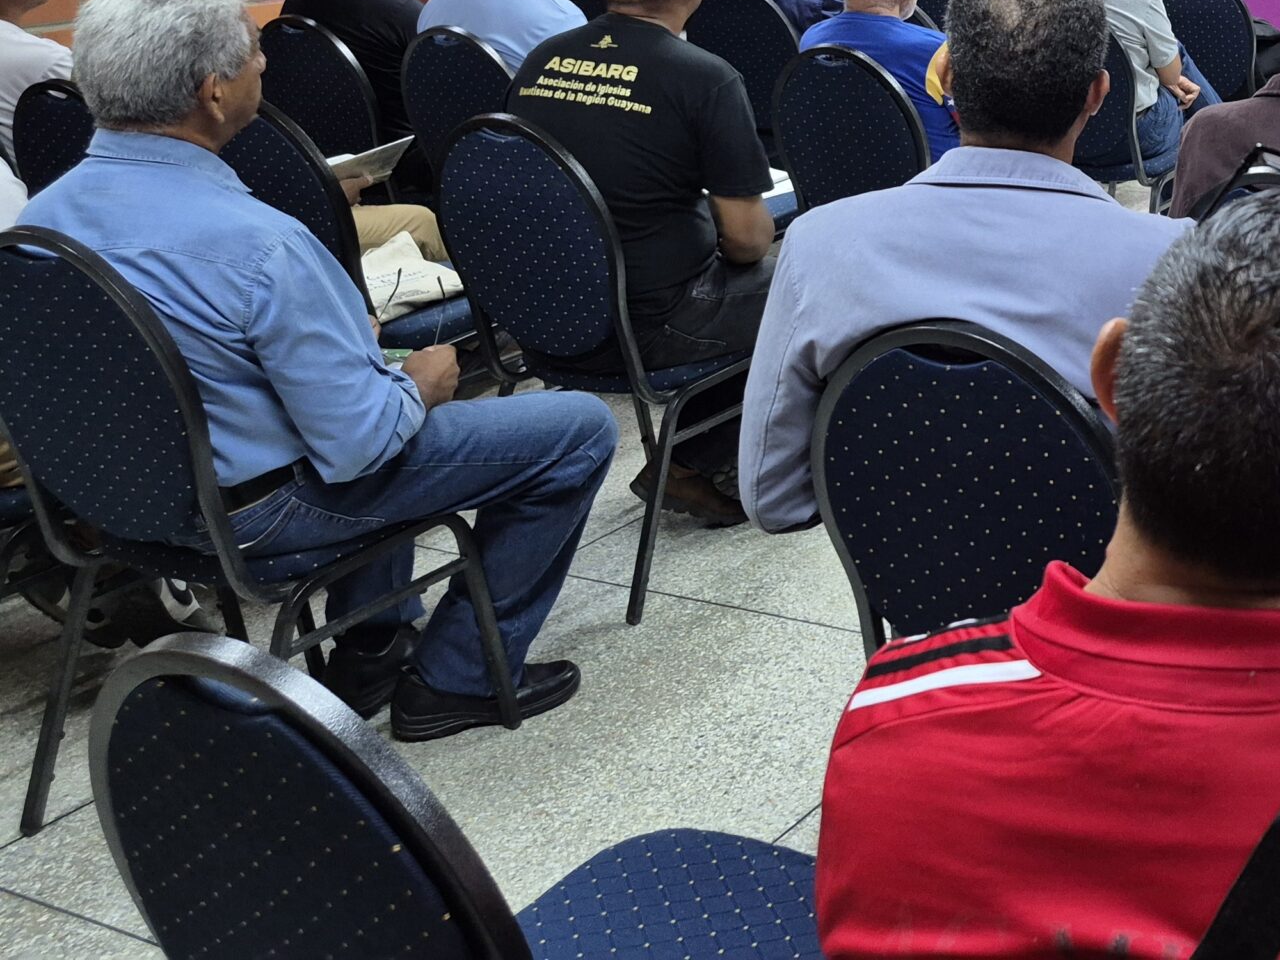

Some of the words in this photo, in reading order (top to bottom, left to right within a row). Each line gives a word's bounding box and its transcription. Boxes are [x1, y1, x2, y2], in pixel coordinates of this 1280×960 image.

[544, 56, 638, 82] ASIBARG
[536, 75, 585, 91] Asociación
[585, 82, 597, 92] de
[597, 84, 632, 97] Iglesias
[554, 89, 566, 100] de
[566, 91, 576, 101] la
[576, 93, 606, 105] Región
[607, 96, 652, 114] Guayana
